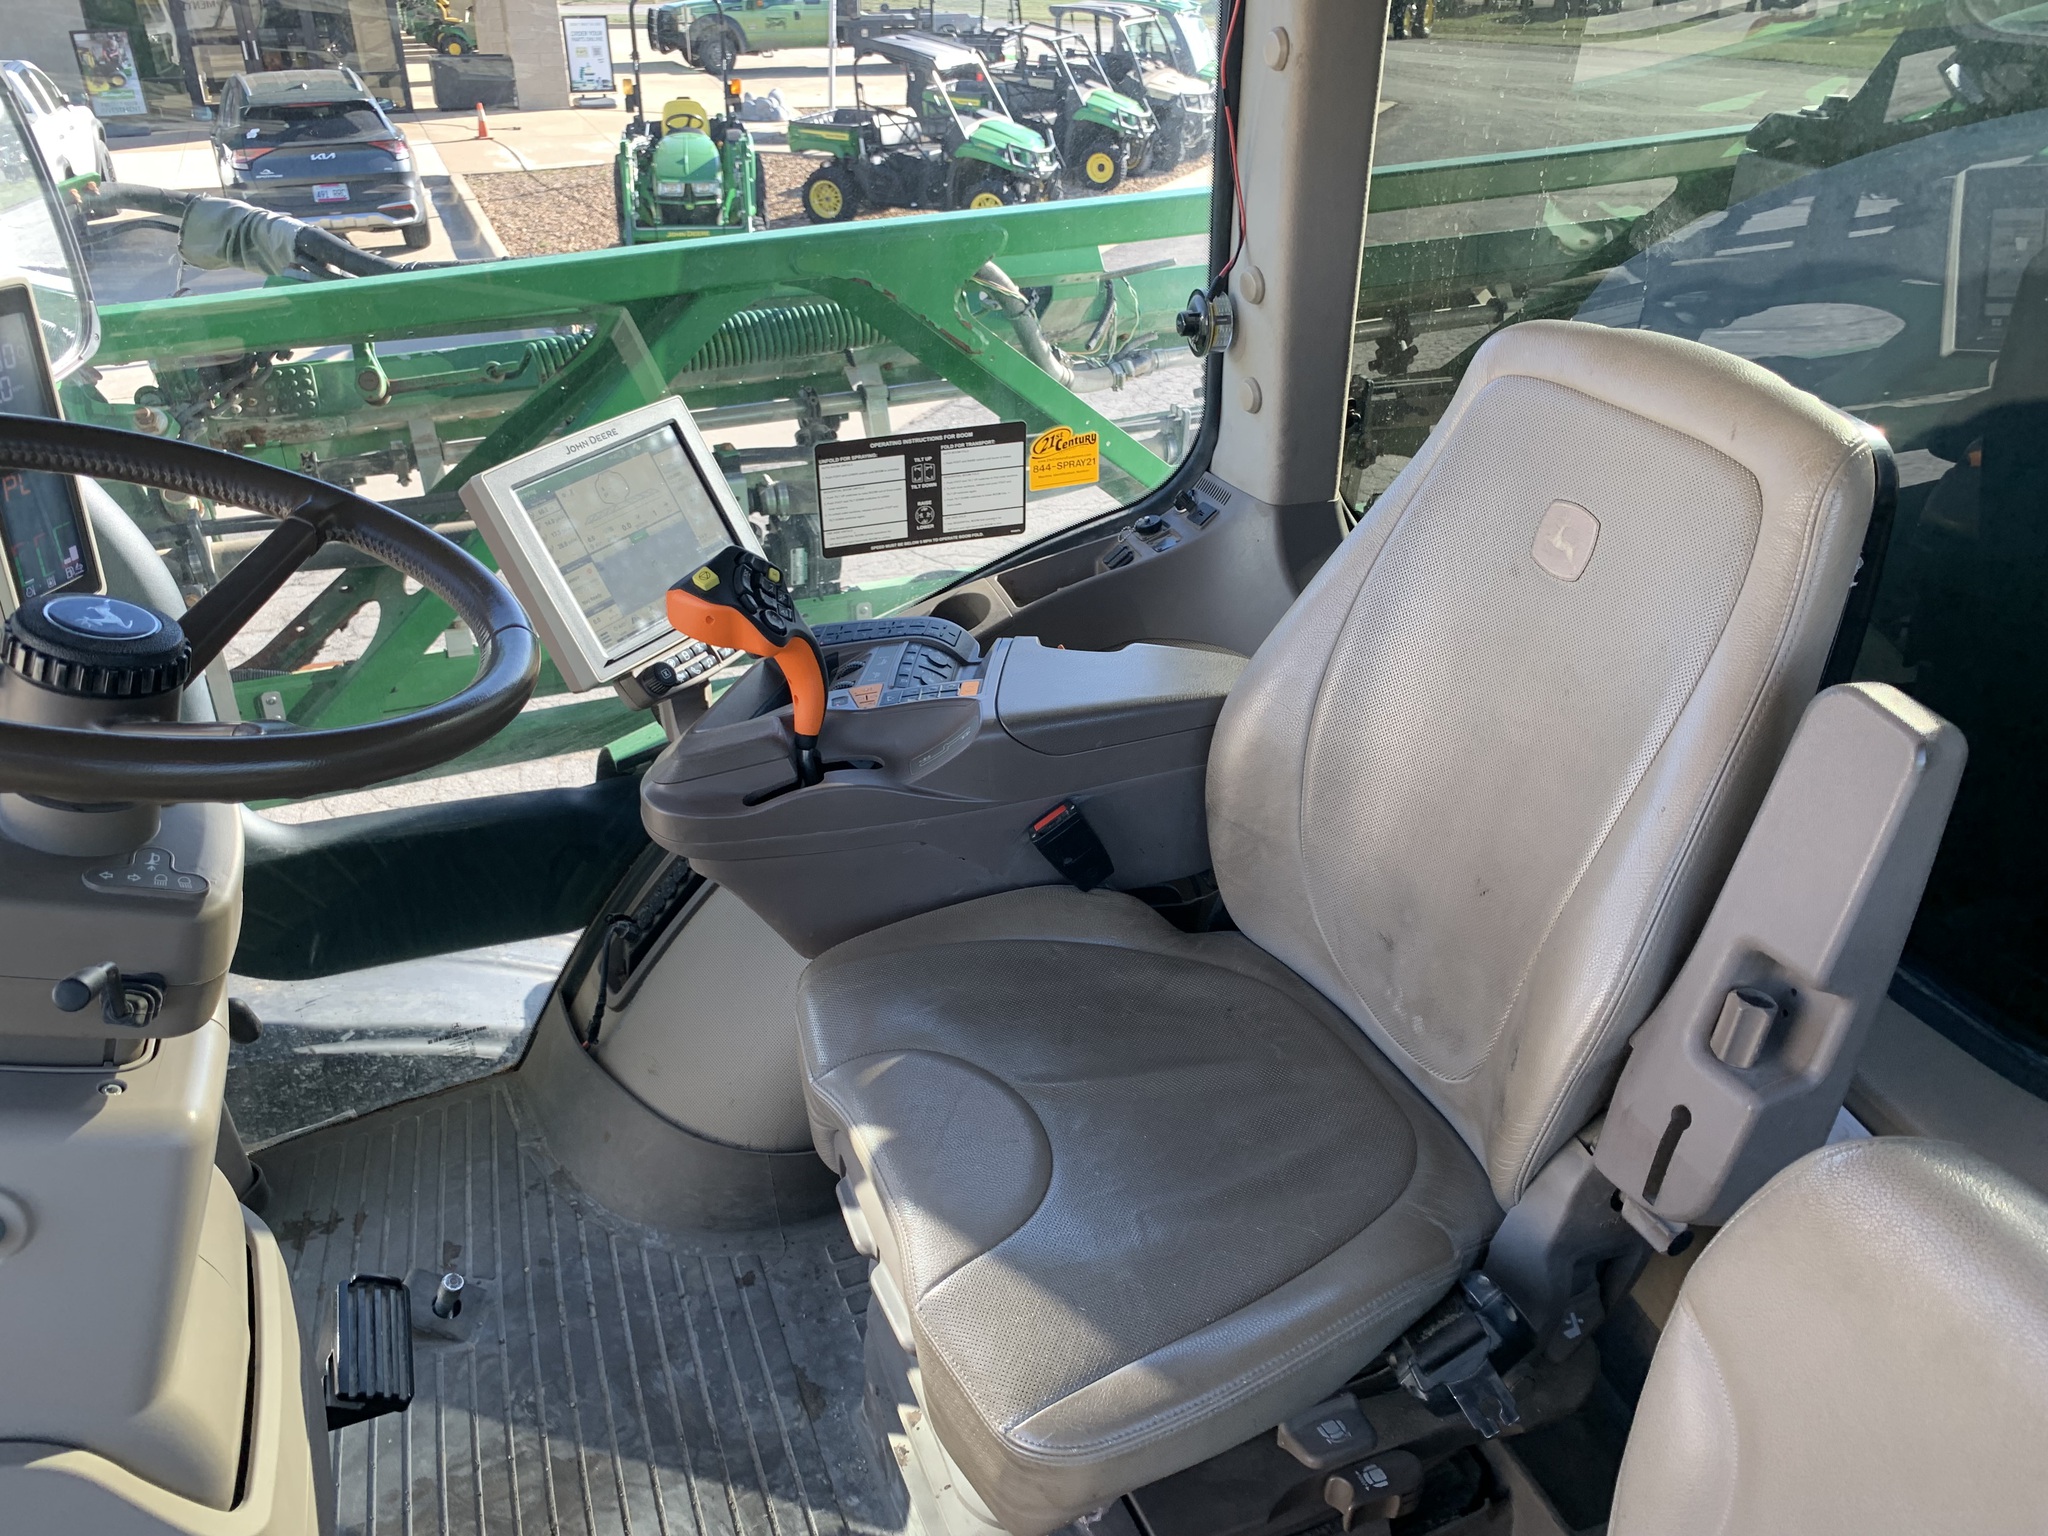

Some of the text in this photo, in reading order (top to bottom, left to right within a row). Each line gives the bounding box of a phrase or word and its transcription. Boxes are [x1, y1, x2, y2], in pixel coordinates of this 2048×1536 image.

[565, 428, 619, 455] JOHN DEERE
[869, 439, 902, 449] OPERATING
[903, 435, 943, 445] INSTRUCTIONS
[956, 431, 974, 439] BOOM
[1033, 457, 1096, 473] 844-SPRAY21
